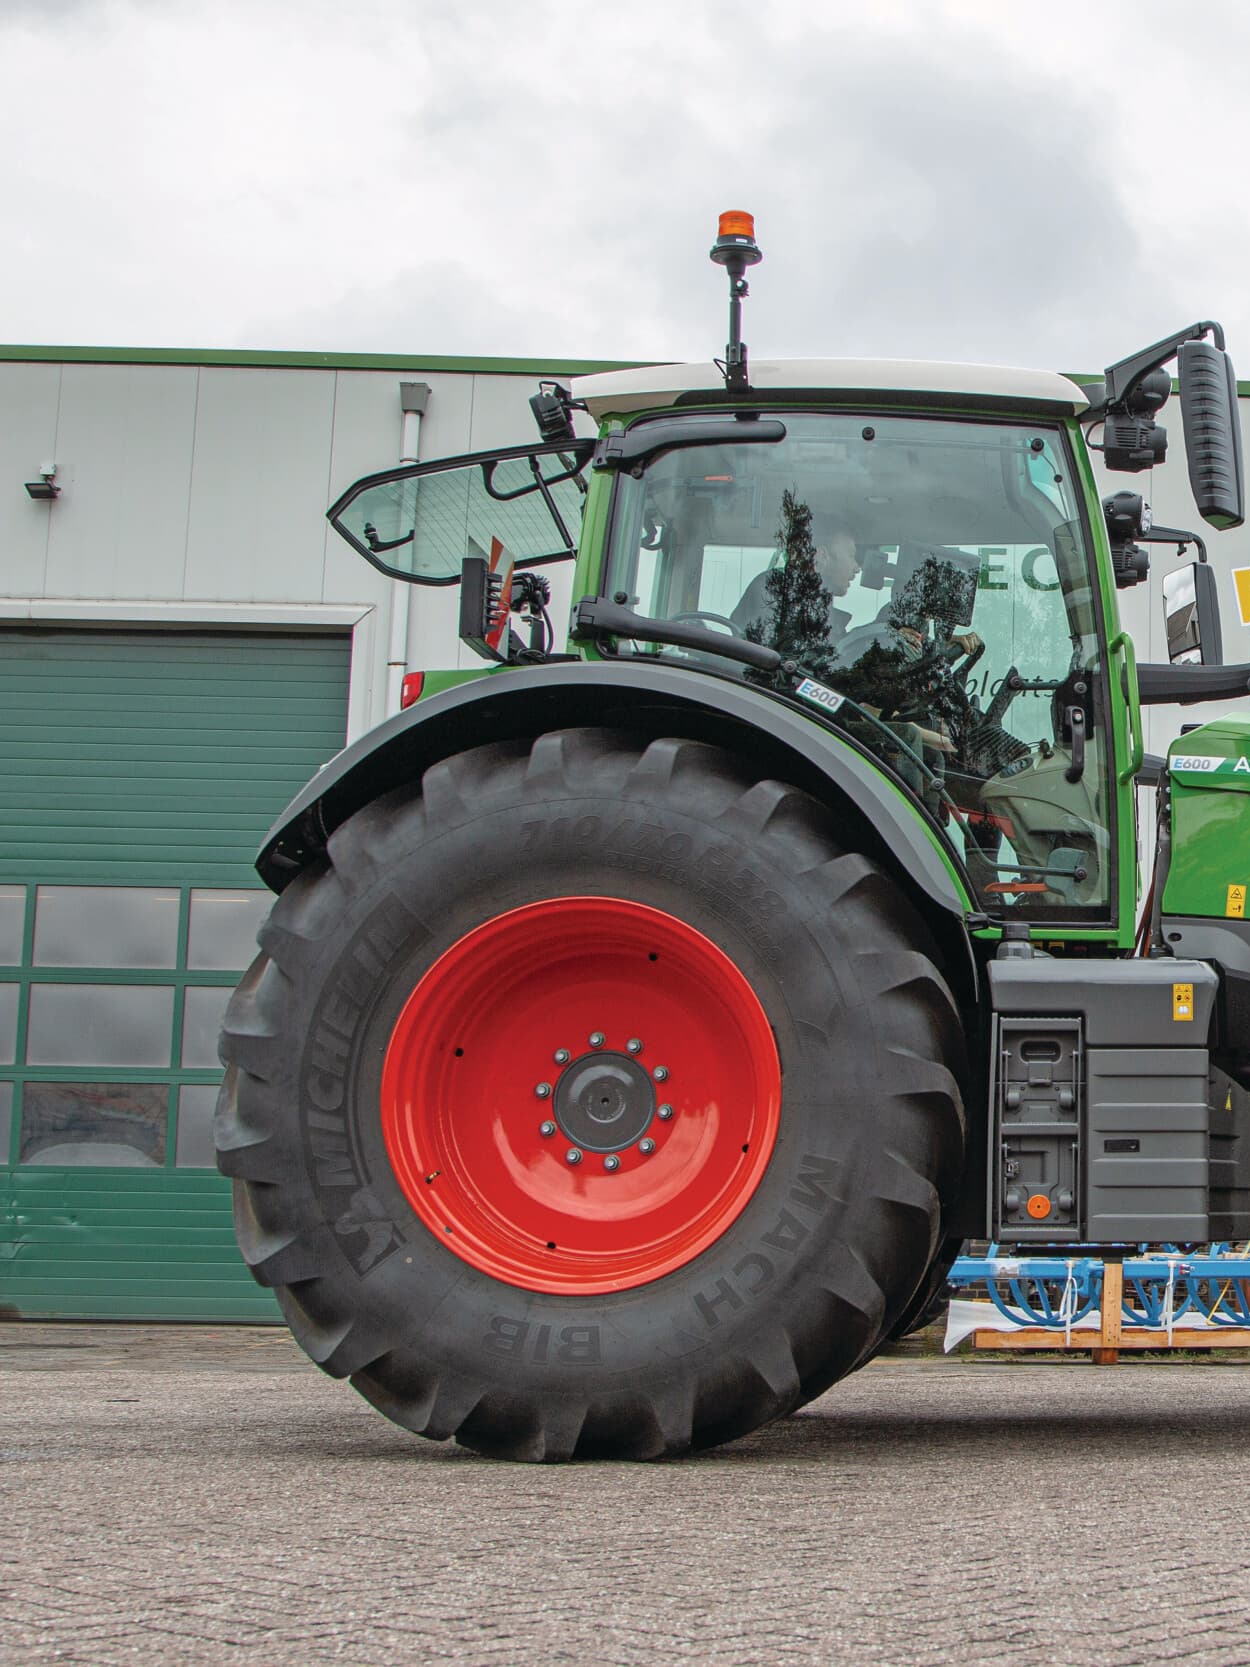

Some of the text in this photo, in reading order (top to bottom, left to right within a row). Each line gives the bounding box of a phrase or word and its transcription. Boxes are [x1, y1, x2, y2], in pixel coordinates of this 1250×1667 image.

[800, 682, 839, 707] E600
[1173, 758, 1211, 770] E600
[307, 904, 409, 1186] MICHELIN
[692, 1152, 844, 1329] MACH
[482, 1315, 601, 1366] BIB
